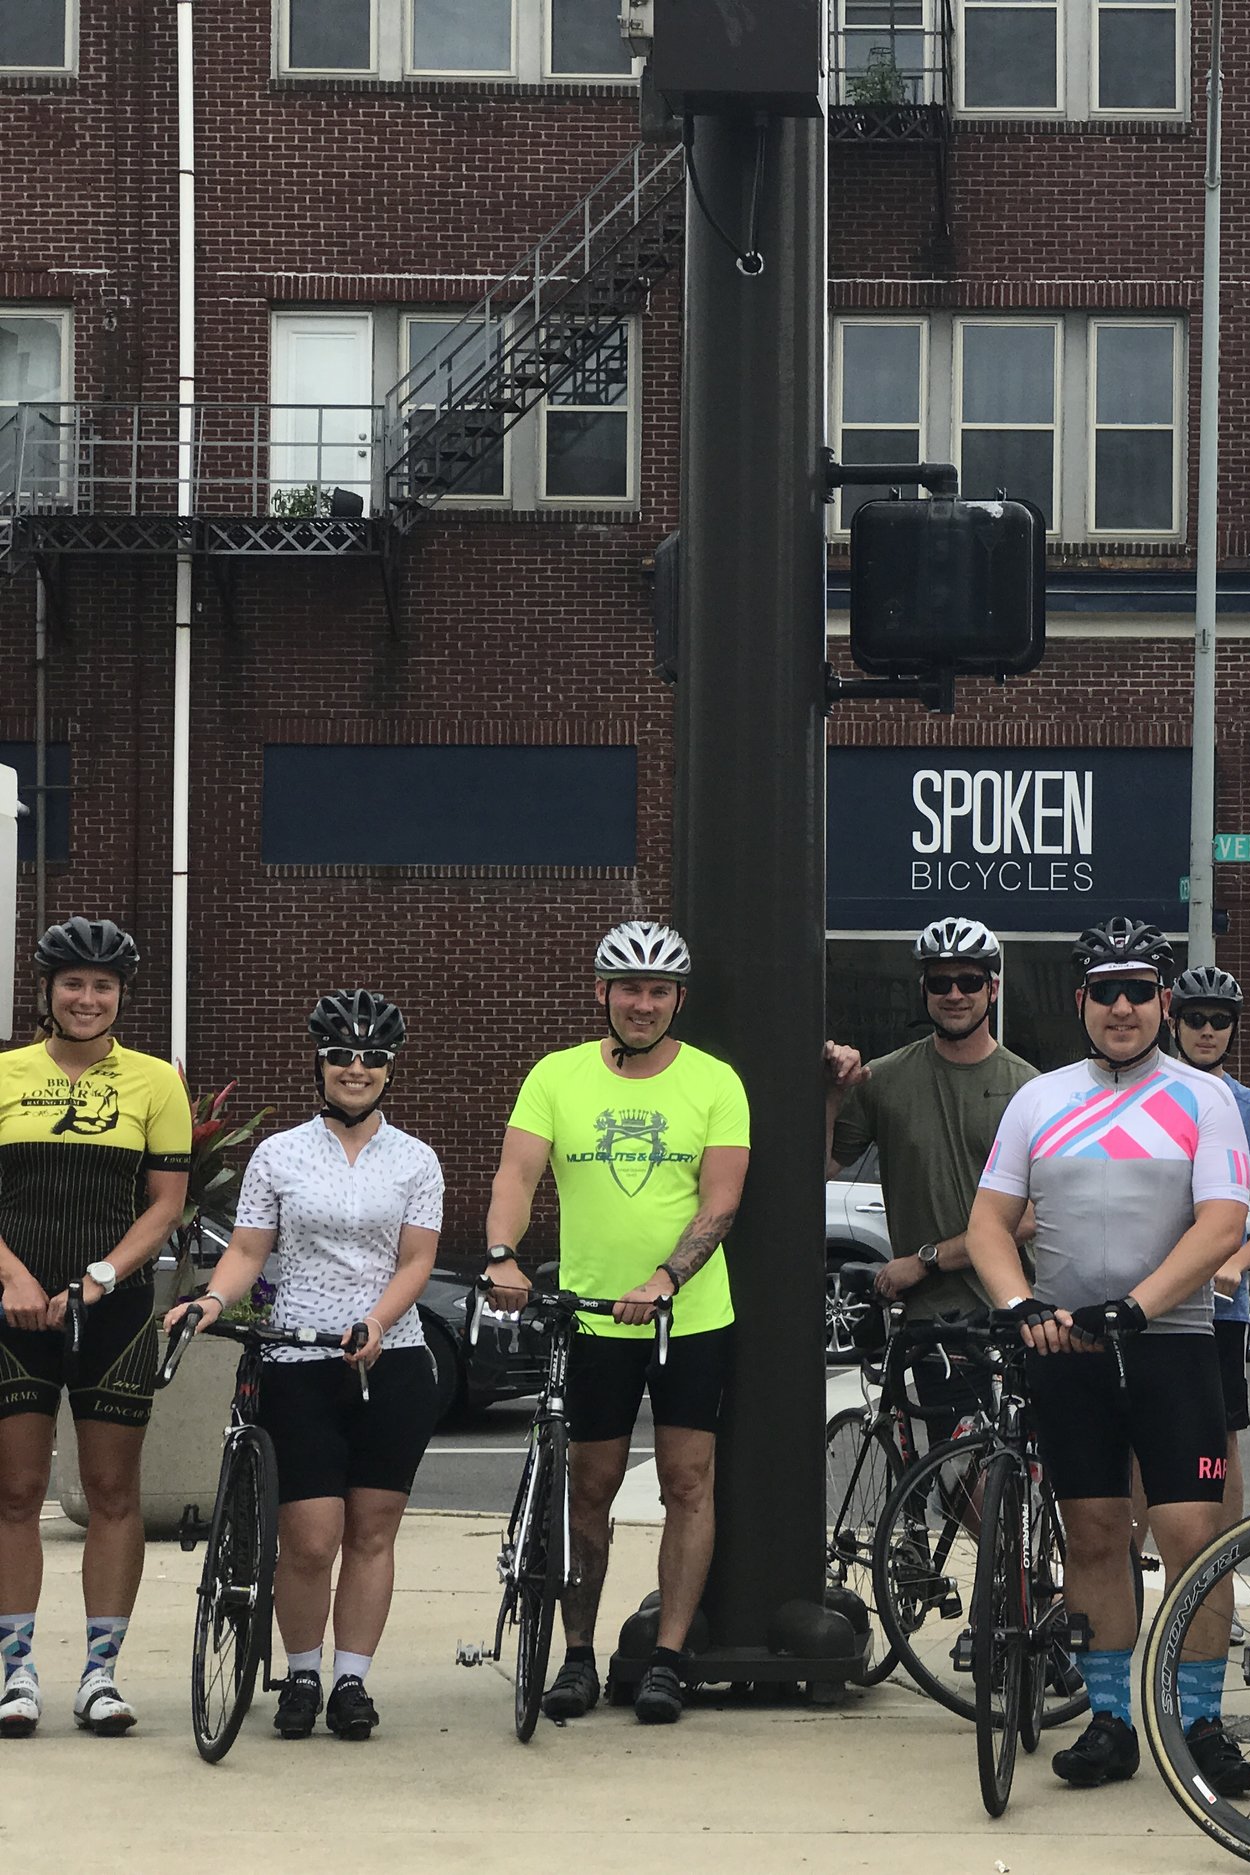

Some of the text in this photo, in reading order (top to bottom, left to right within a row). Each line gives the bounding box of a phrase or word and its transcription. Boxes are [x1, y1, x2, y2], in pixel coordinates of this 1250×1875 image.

[912, 769, 1093, 855] SPOKEN
[911, 861, 1093, 891] BICYCLES
[566, 1153, 593, 1163] MUD
[595, 1152, 636, 1163] GUTS
[649, 1152, 697, 1164] GLORY
[1022, 1503, 1030, 1569] PINARELLO
[1161, 1544, 1240, 1716] REYNOLDS
